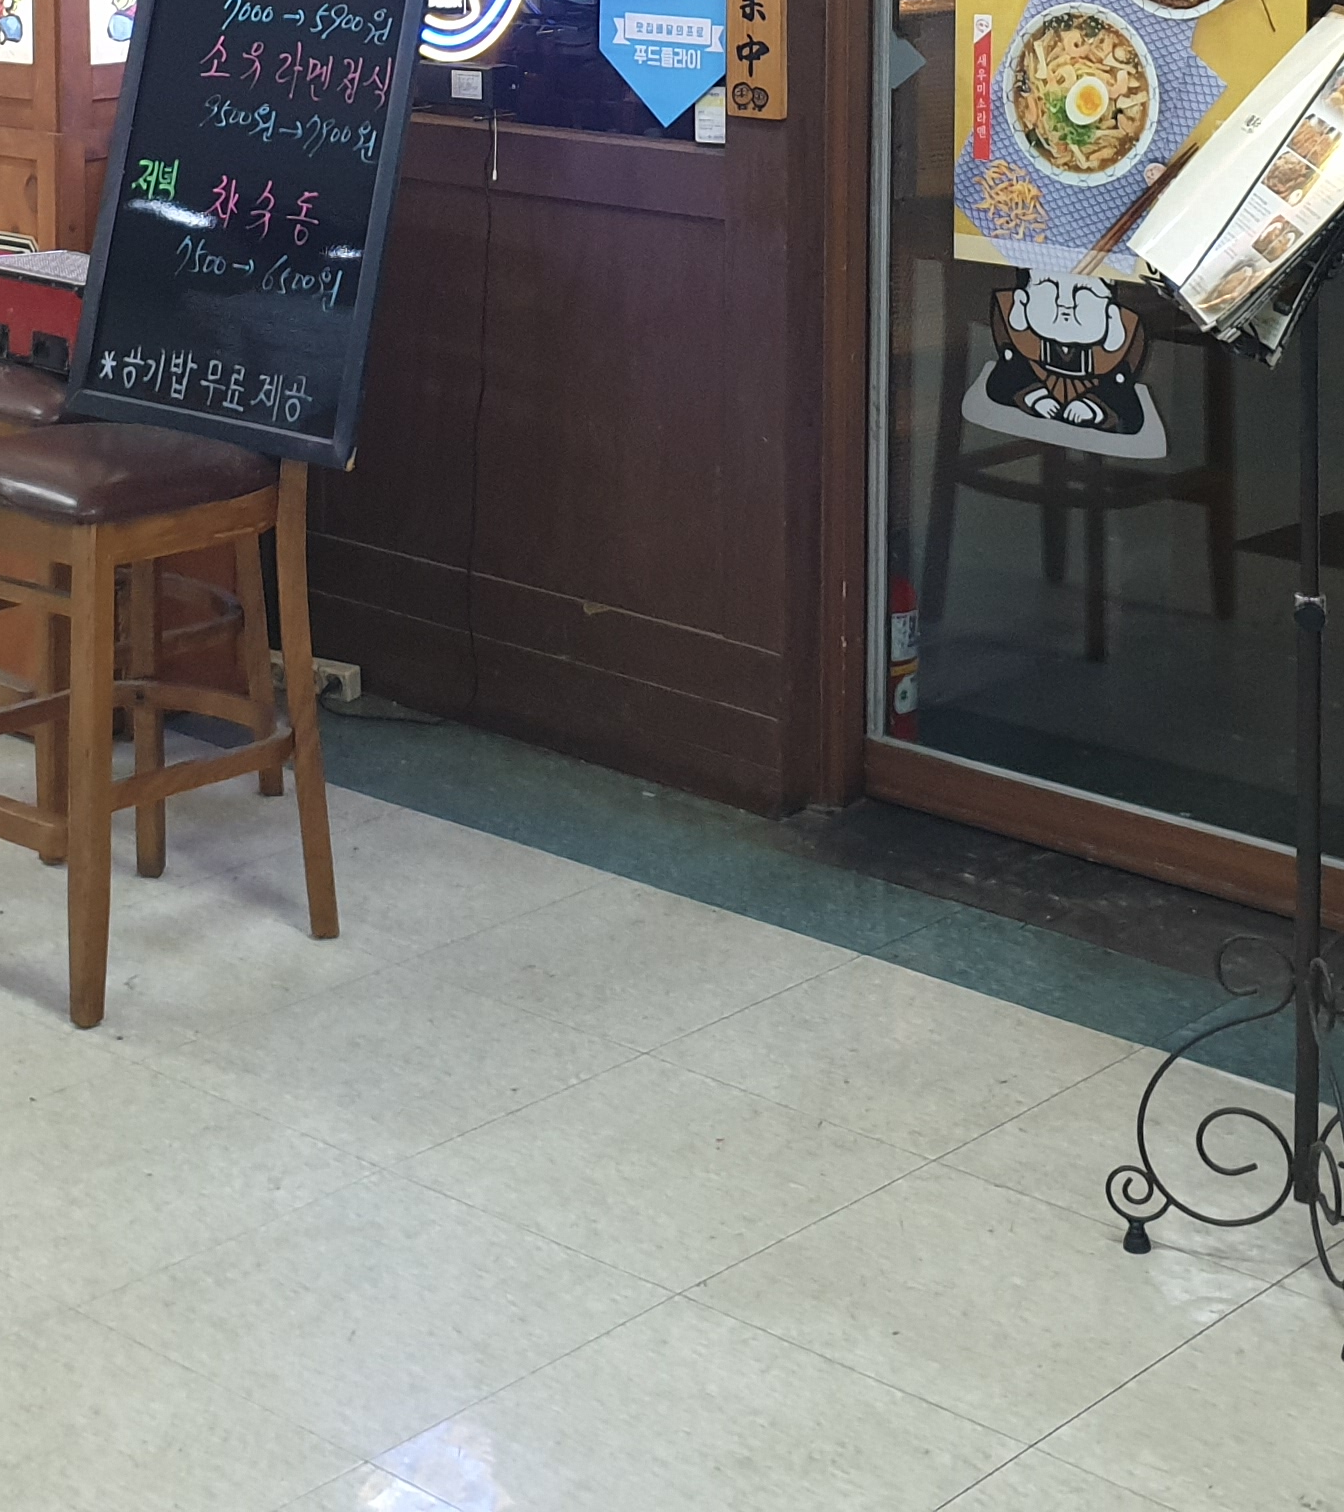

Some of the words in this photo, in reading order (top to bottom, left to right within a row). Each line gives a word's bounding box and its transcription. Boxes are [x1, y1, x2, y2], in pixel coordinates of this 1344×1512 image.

[131, 158, 181, 201] 저녁
[200, 359, 246, 412] 무료
[250, 373, 314, 423] 제공
